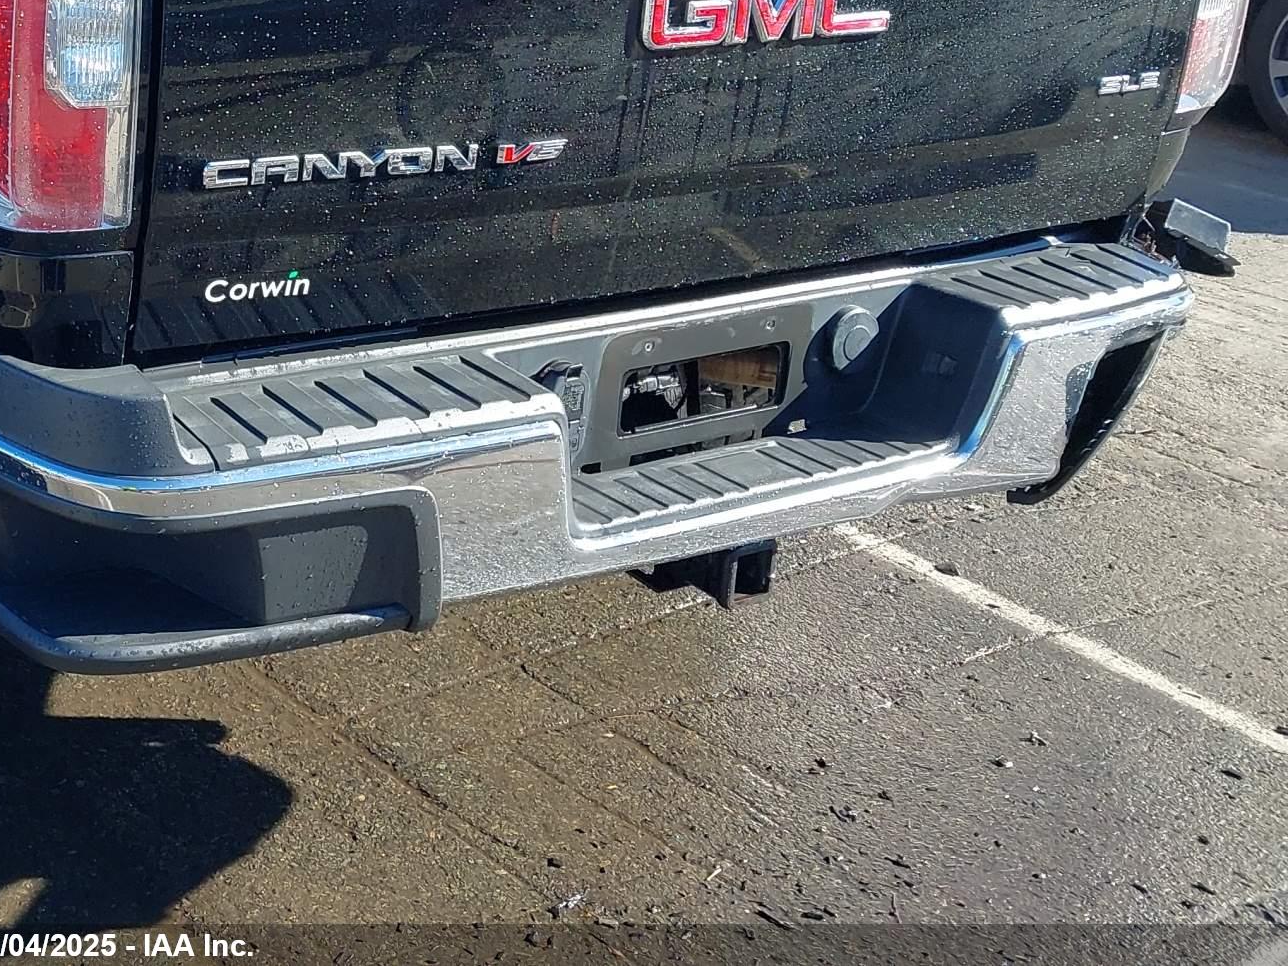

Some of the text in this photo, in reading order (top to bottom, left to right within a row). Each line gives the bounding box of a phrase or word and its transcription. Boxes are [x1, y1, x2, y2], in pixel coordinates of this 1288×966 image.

[202, 138, 569, 190] CANYON V6
[204, 269, 311, 303] Corwin
